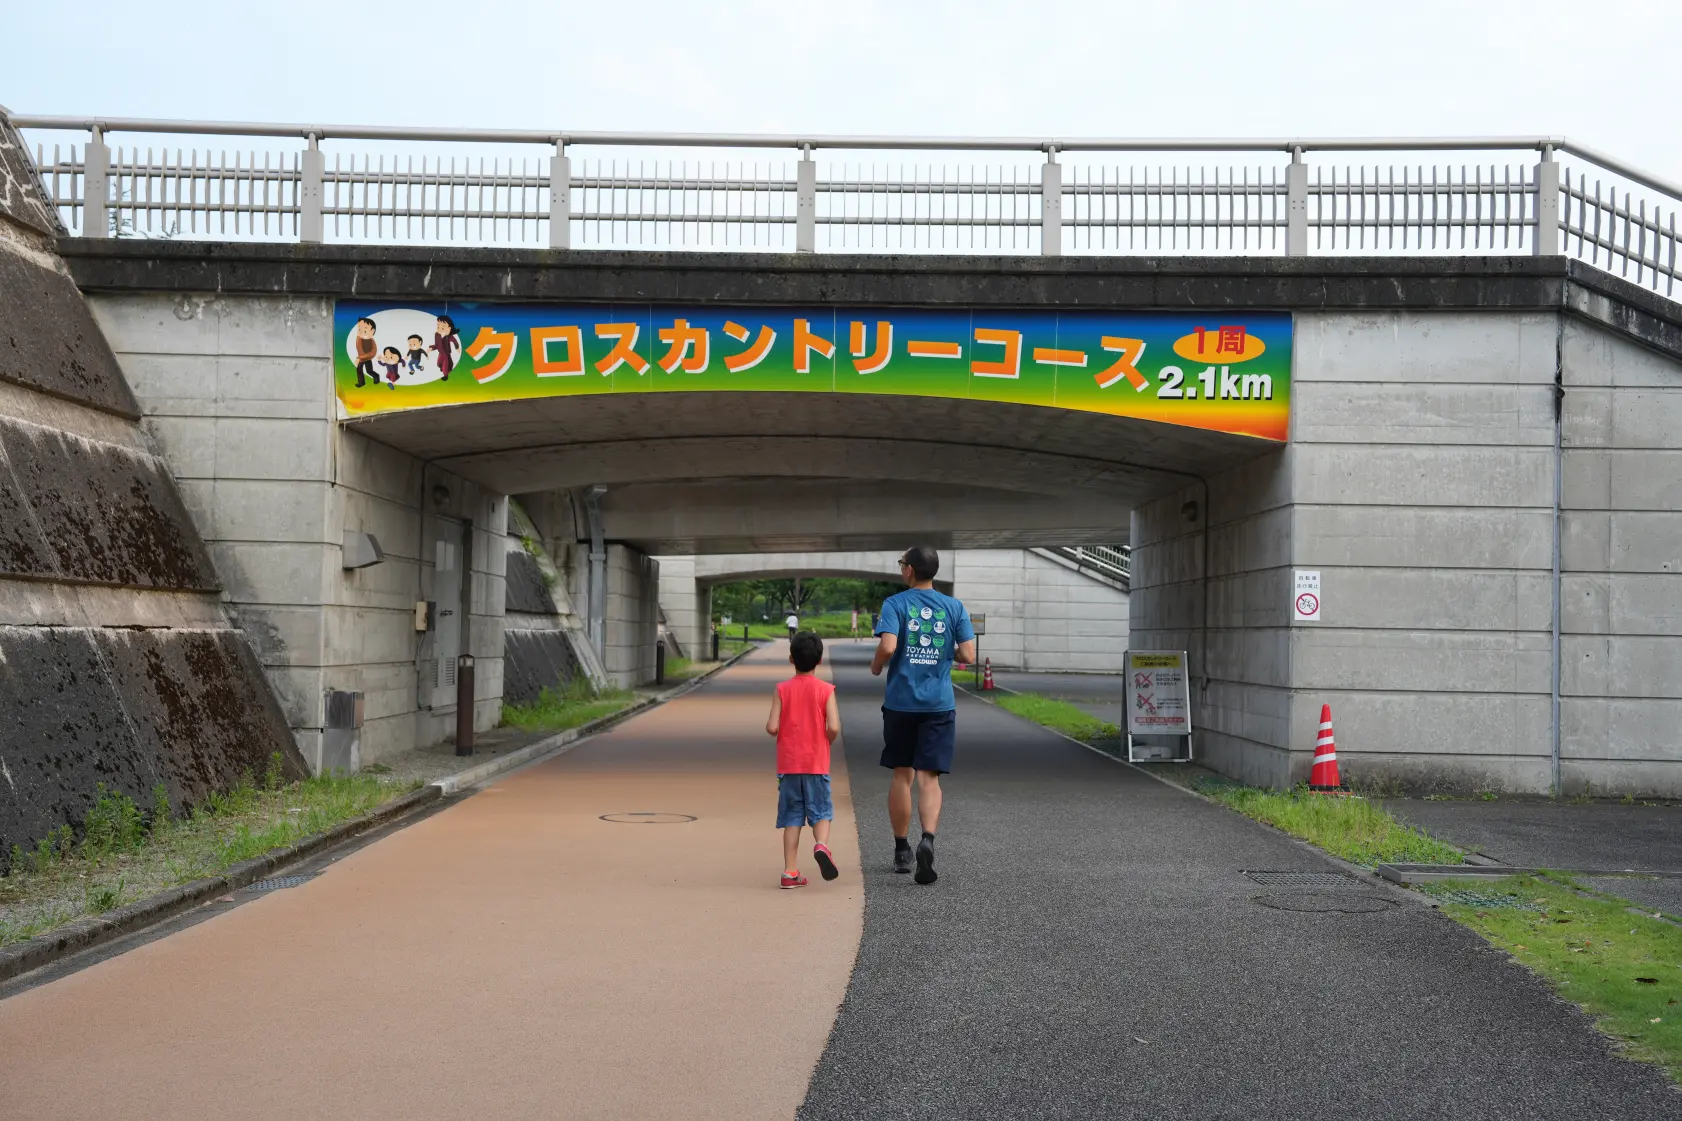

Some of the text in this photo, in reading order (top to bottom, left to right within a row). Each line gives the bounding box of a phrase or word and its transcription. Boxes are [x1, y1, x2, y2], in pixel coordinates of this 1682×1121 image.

[465, 318, 1149, 393] クロスカントリーコース
[1193, 325, 1246, 355] 1周
[1157, 365, 1273, 400] 2.1km
[906, 646, 940, 655] TOYAMA
